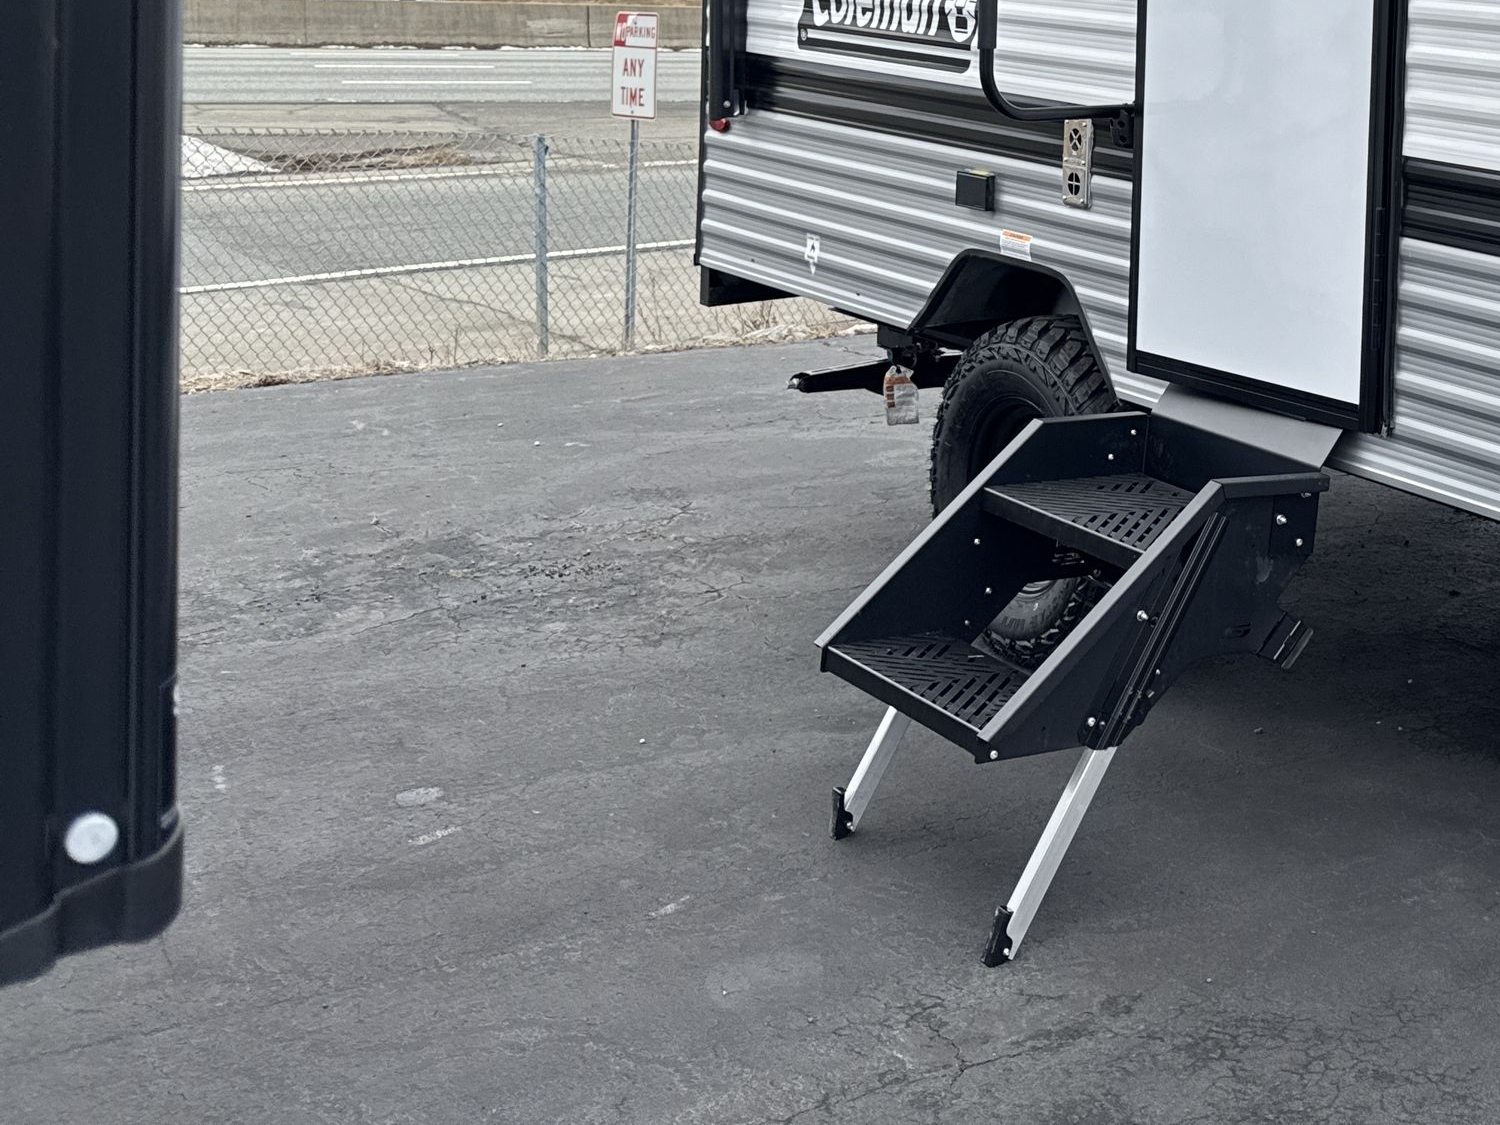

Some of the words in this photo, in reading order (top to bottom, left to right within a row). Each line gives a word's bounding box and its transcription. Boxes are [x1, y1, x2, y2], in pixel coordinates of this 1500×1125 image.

[626, 26, 656, 39] PARKING
[622, 58, 645, 77] ANY
[620, 86, 645, 107] TIME
